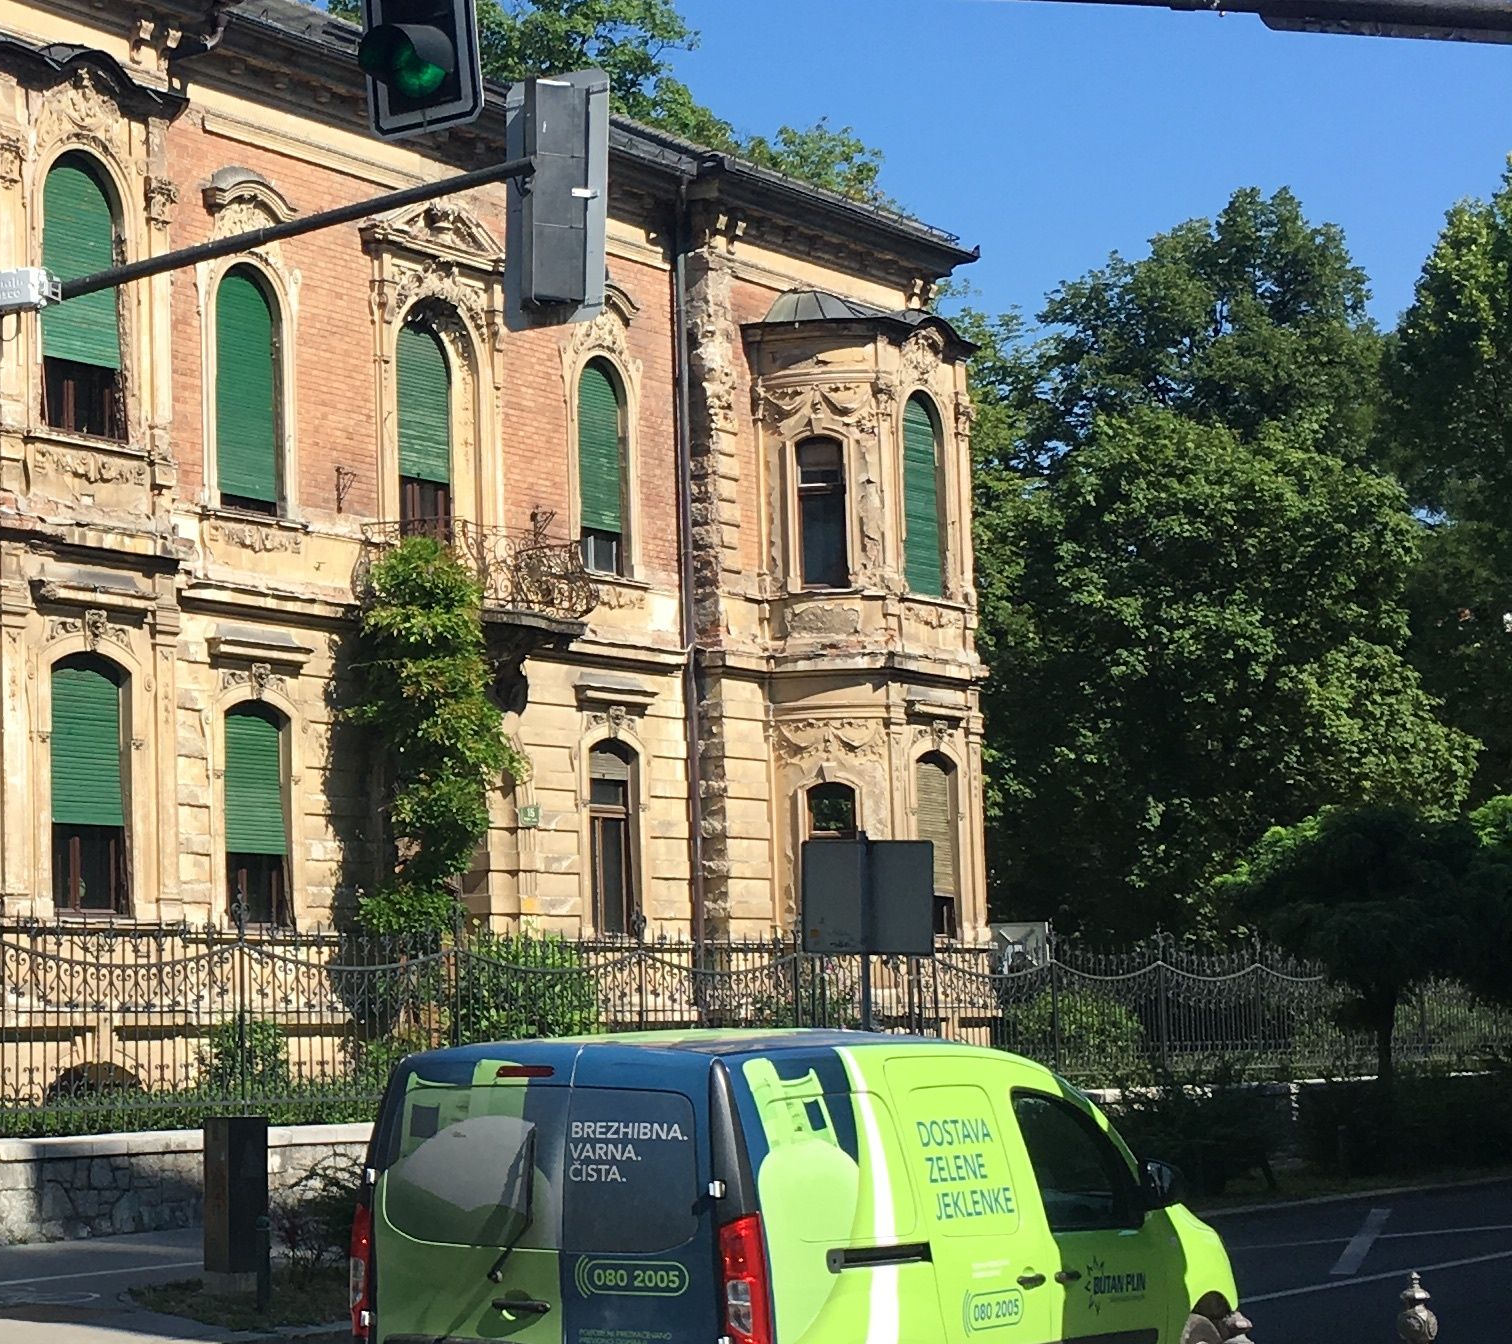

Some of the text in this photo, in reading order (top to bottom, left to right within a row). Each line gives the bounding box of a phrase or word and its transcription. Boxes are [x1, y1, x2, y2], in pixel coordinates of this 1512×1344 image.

[571, 1122, 689, 1141] BREZHIBNA.
[916, 1118, 993, 1147] DOSTAVA
[569, 1142, 642, 1161] VARNA.
[569, 1160, 627, 1182] ČISTA.
[925, 1153, 988, 1183] ZELENE
[936, 1187, 1015, 1221] JEKLENKE
[593, 1269, 680, 1288] 080 2005
[974, 1298, 1020, 1322] 080 2005
